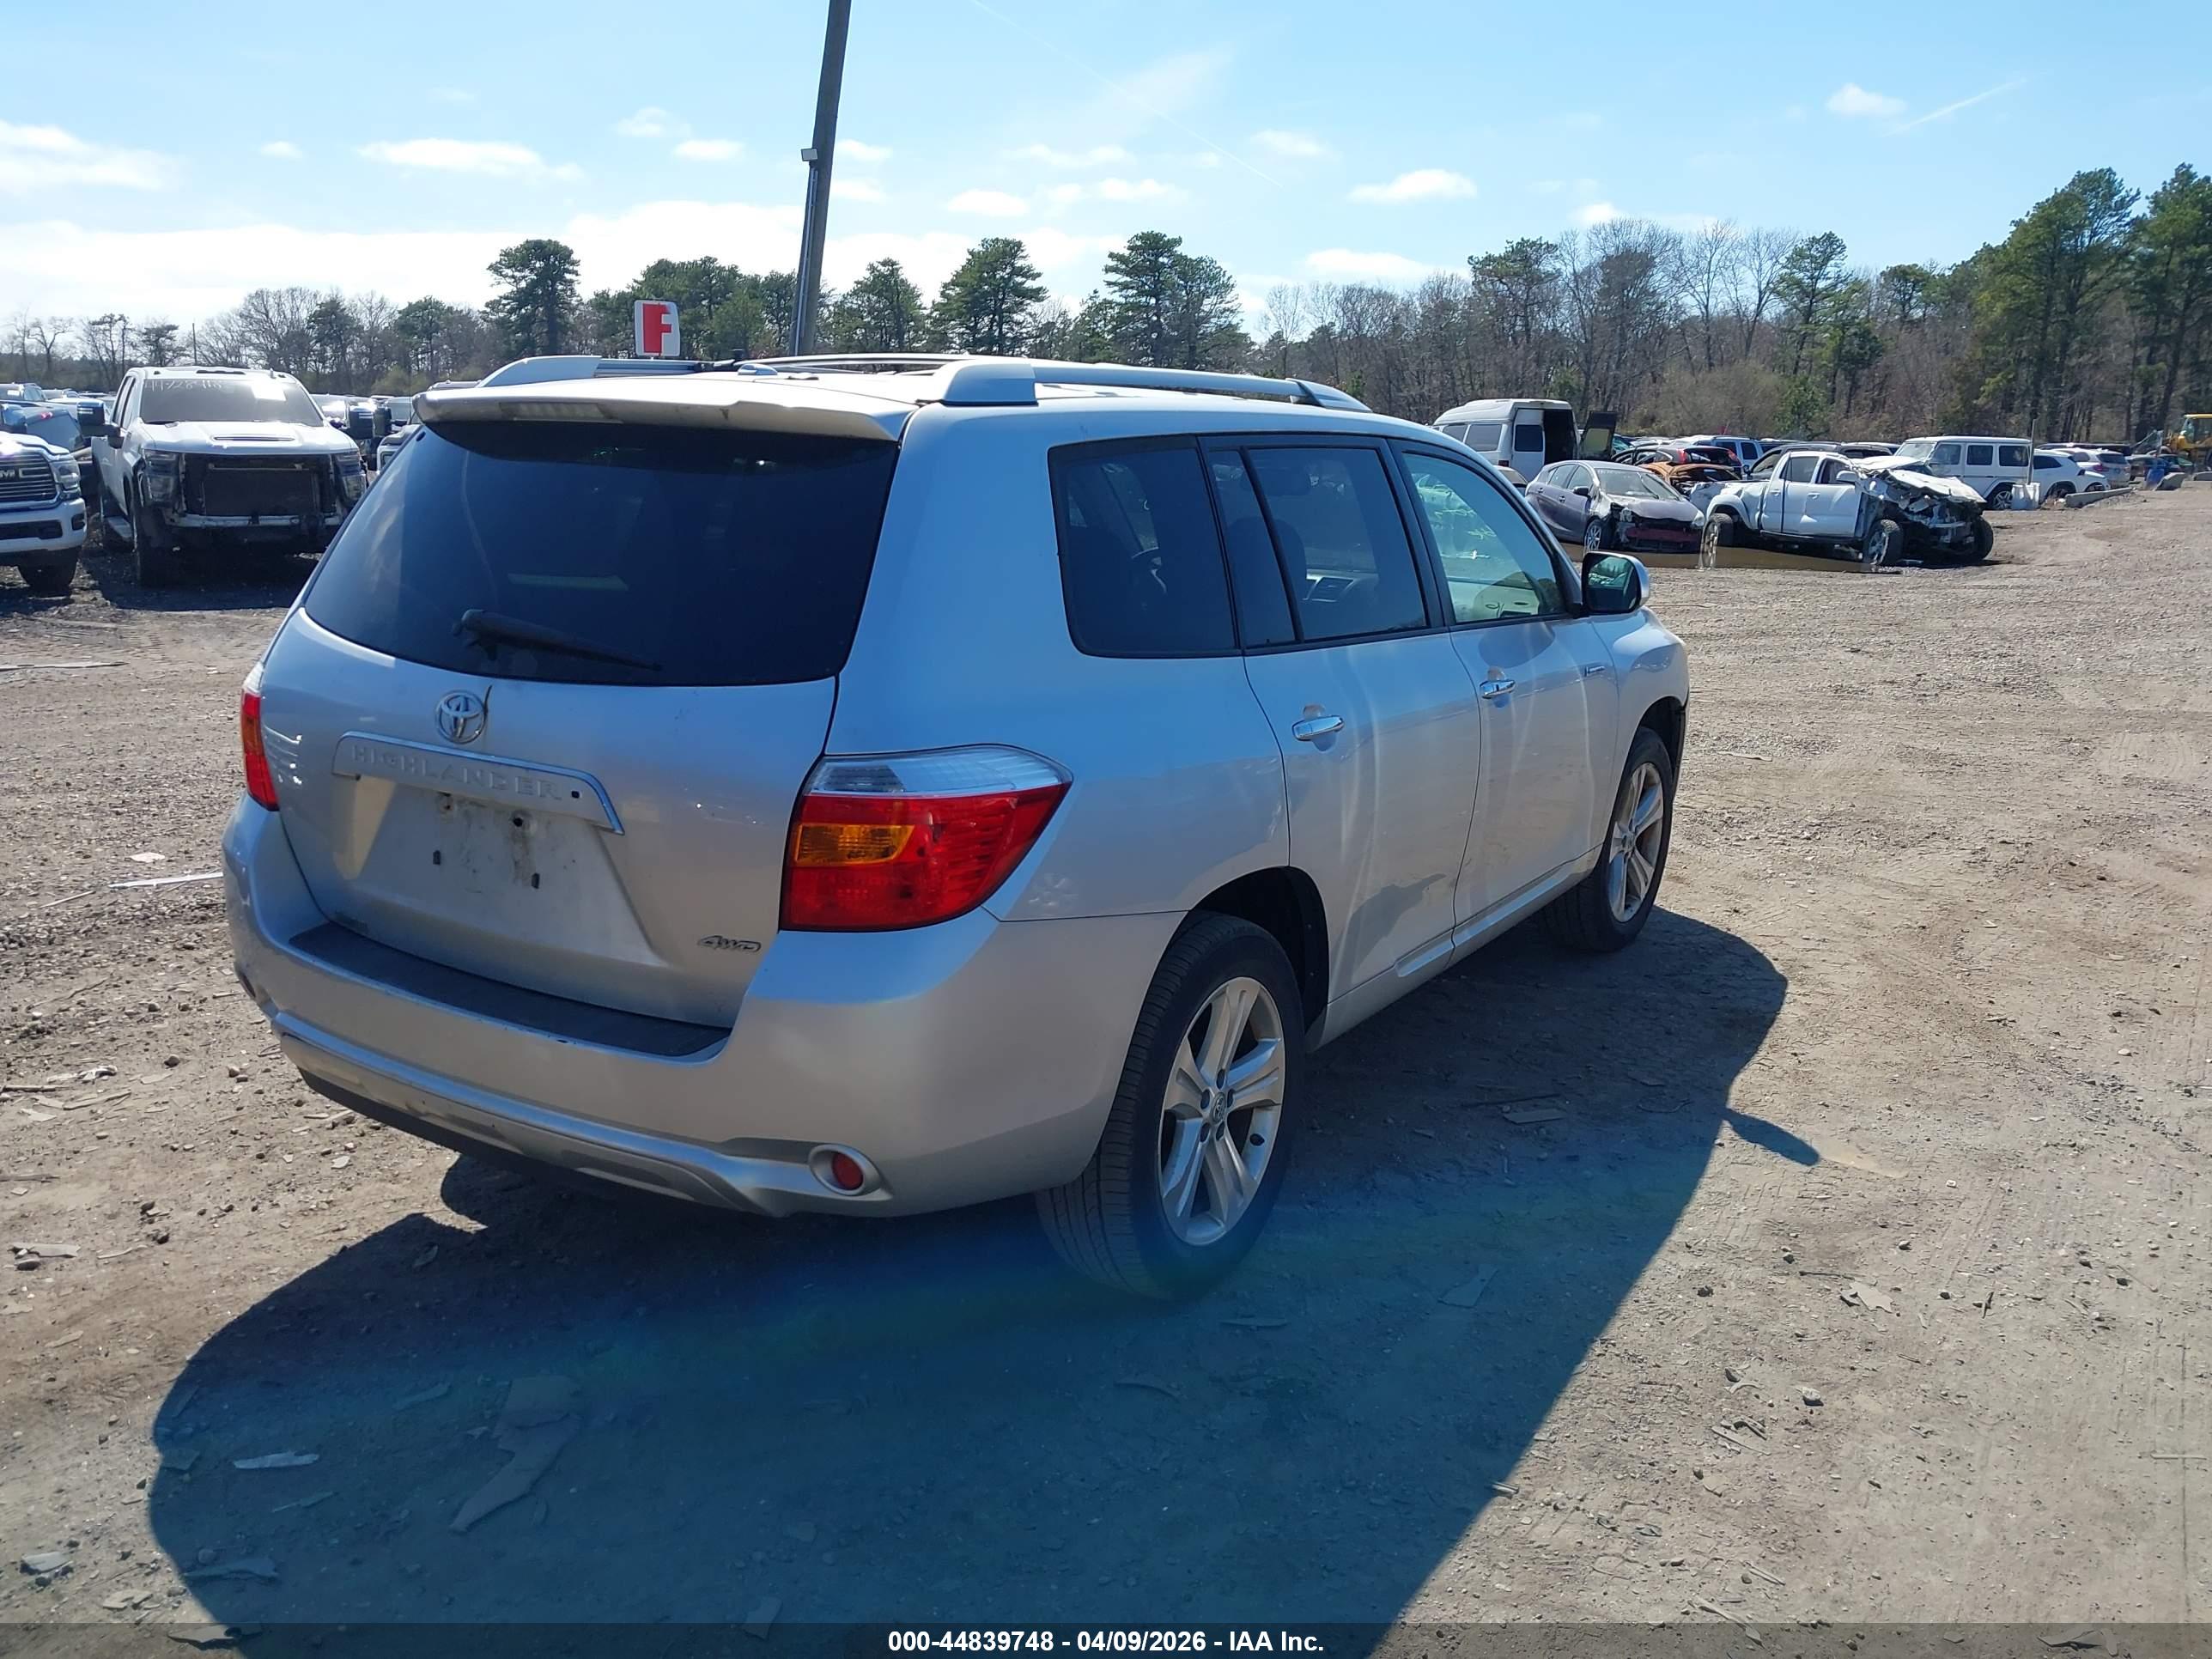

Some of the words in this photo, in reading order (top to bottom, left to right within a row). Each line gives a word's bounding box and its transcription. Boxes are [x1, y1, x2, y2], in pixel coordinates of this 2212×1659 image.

[642, 302, 672, 353] F
[351, 744, 562, 801] HIGHLANDER
[697, 934, 762, 952] 4WD
